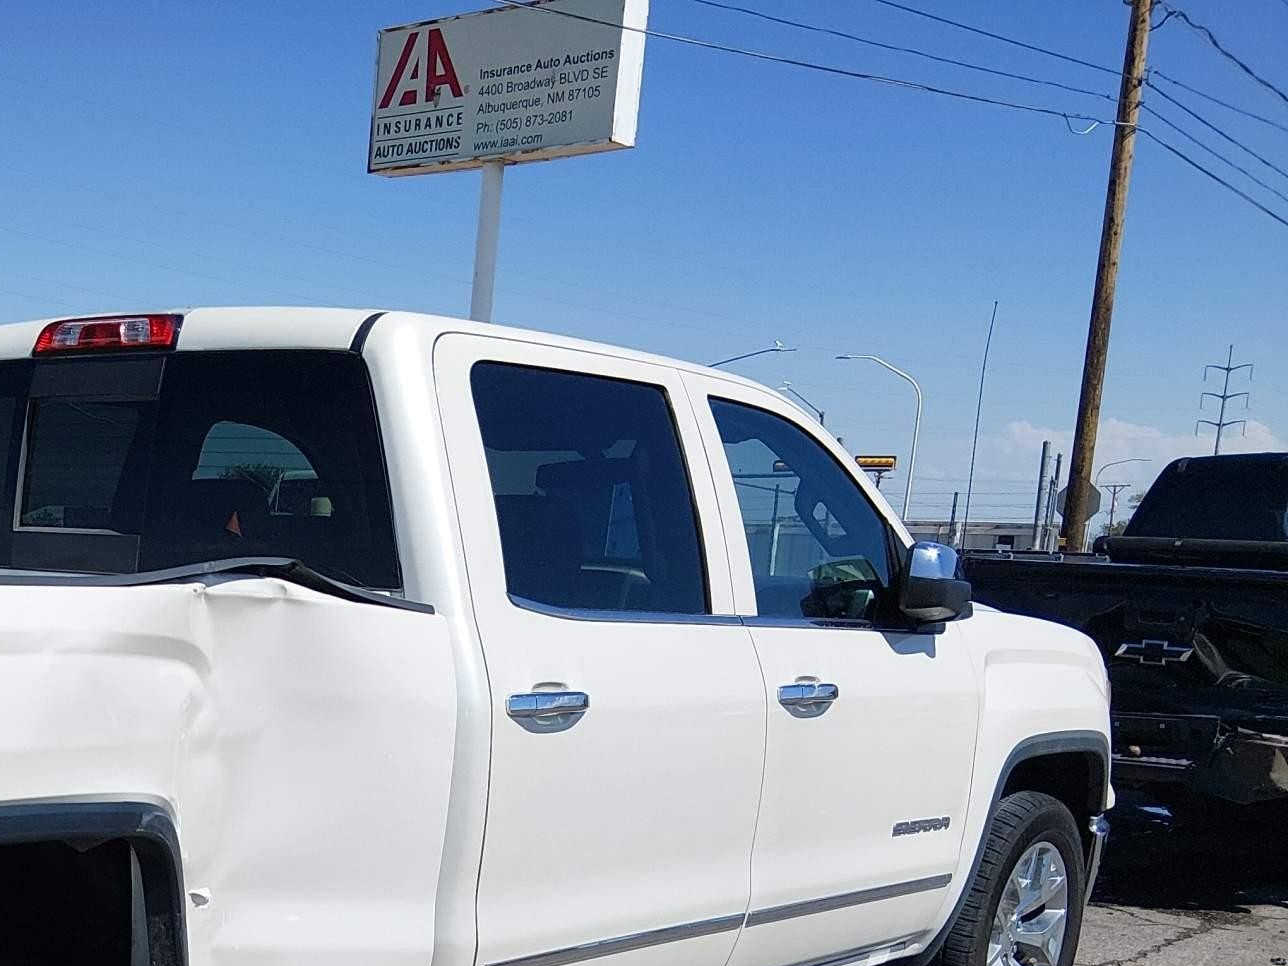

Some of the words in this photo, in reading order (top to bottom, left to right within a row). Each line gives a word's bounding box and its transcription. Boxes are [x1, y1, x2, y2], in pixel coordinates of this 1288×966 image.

[479, 63, 532, 80] Insurance
[535, 58, 560, 71] Auto
[563, 49, 615, 66] Auctions
[478, 82, 503, 96] 4400
[506, 76, 556, 93] Broadway
[559, 69, 590, 85] BLVD
[592, 66, 609, 80] SE
[477, 97, 544, 116] Albuquerque,
[547, 91, 565, 104] NM
[568, 85, 601, 101] 87105
[376, 112, 463, 136] INSURANCE
[476, 122, 493, 134] Ph:
[495, 117, 523, 134] (505)
[525, 110, 573, 128] 873-2081
[374, 143, 404, 159] AUTO
[406, 135, 461, 155] AUCTIONS
[473, 134, 543, 152] www.iaai.com
